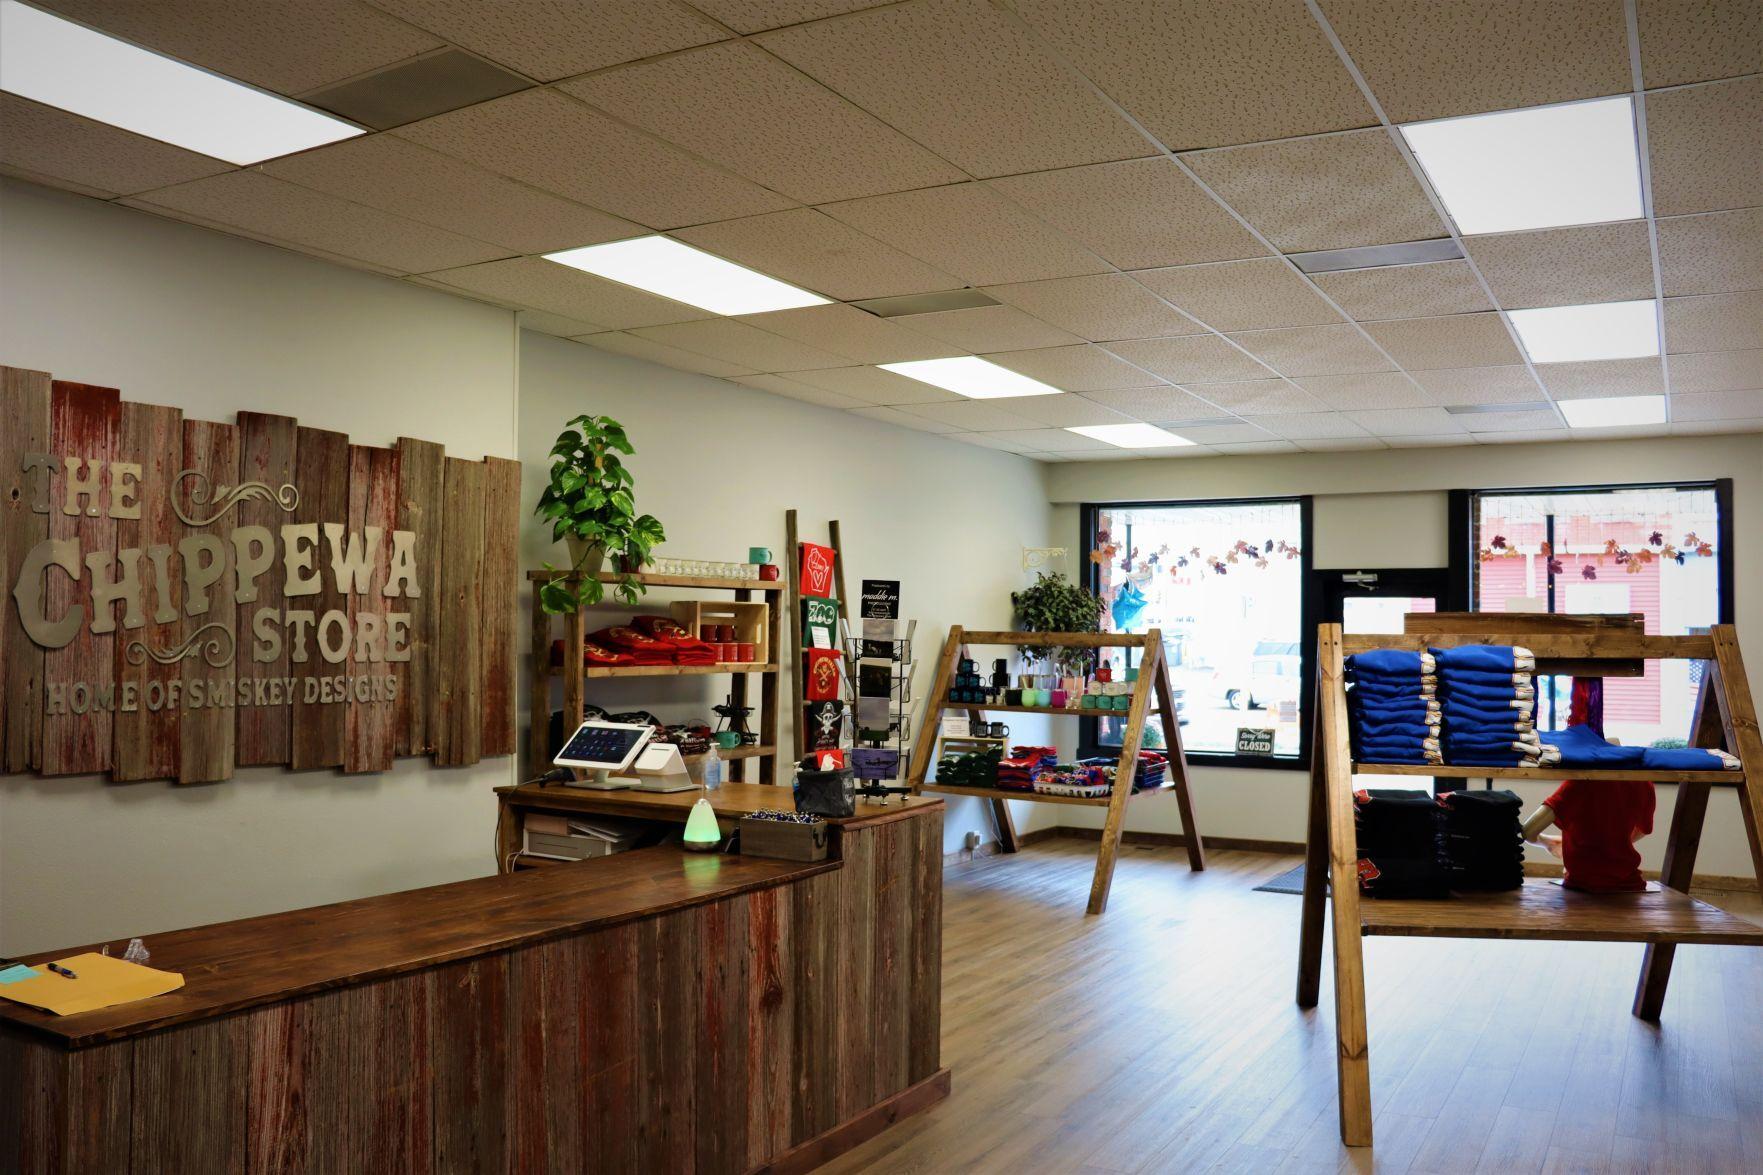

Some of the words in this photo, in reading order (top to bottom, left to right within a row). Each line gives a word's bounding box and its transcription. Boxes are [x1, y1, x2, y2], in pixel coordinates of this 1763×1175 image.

[23, 452, 142, 519] THE
[13, 522, 421, 649] CHIPPEWA
[252, 607, 411, 664] STORE
[46, 680, 138, 715] HOME
[146, 679, 182, 712] OF
[189, 676, 298, 708] SMISKEY
[303, 674, 398, 705] DESIGNS
[1239, 741, 1270, 751] CLOSED
